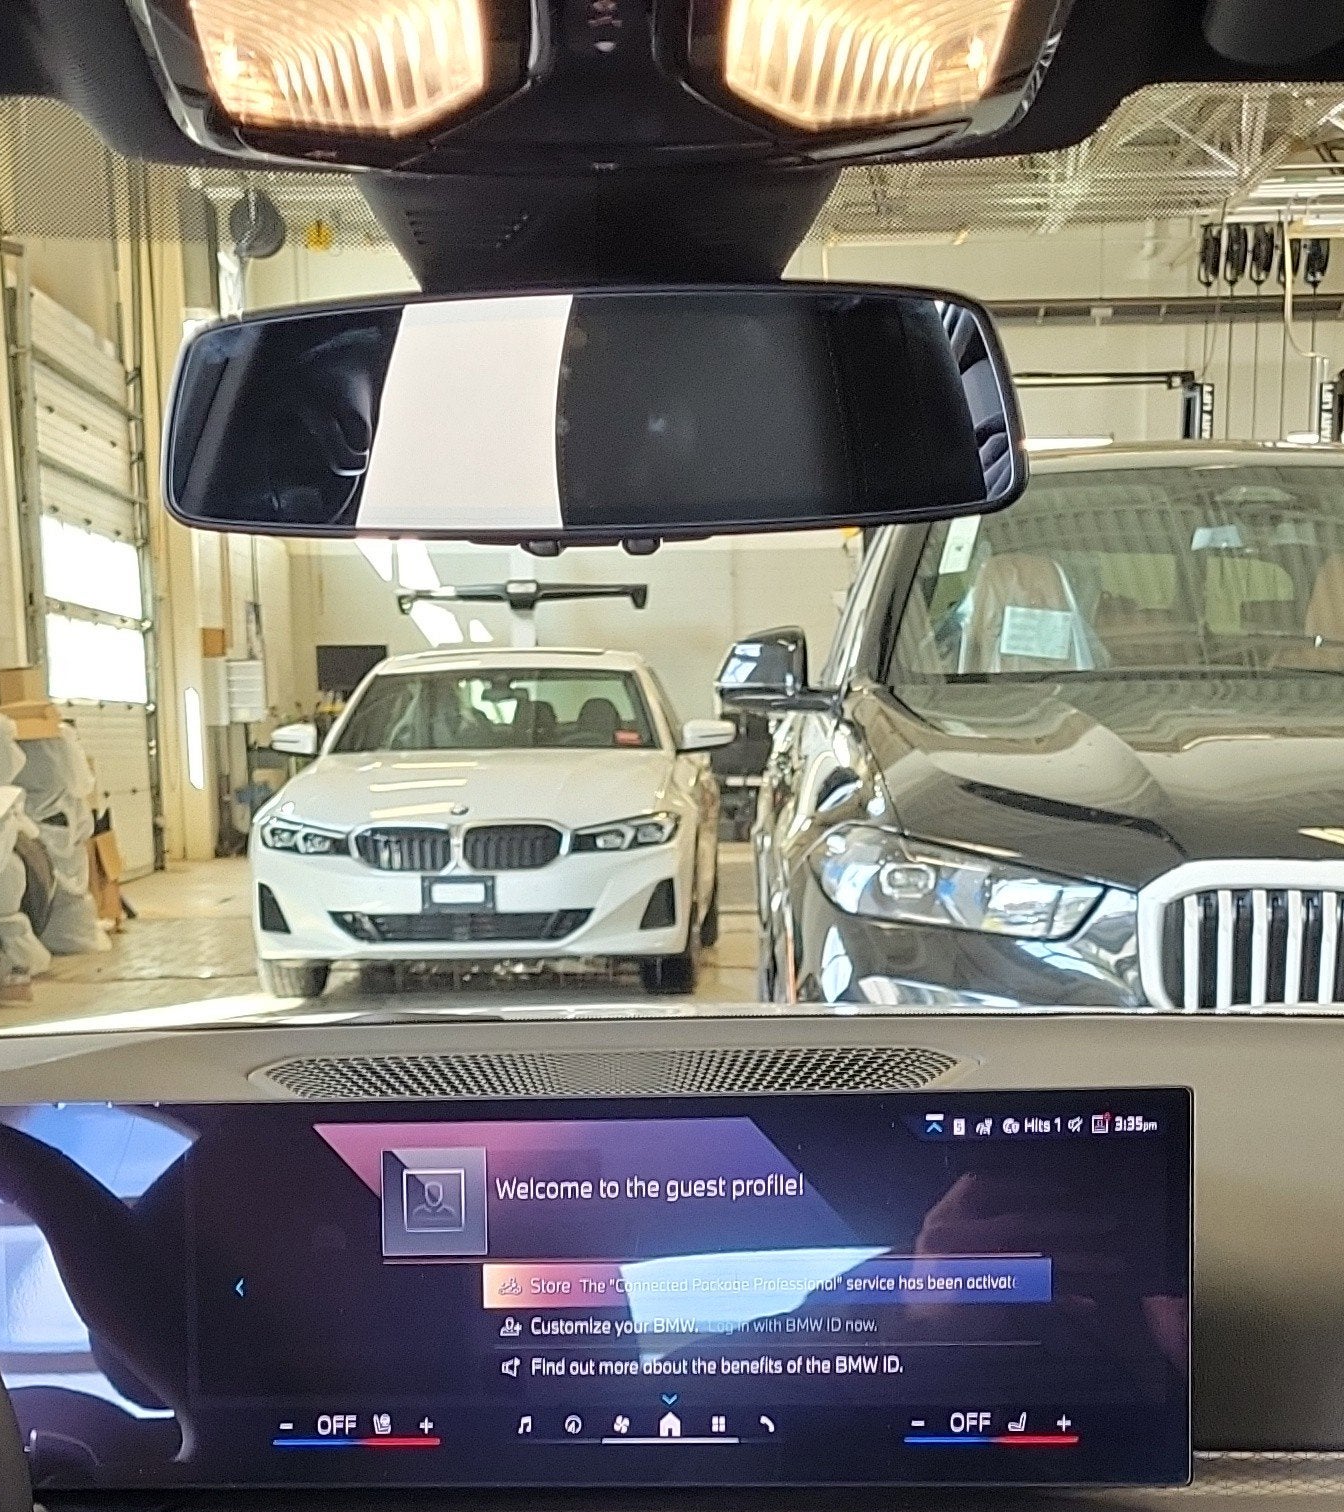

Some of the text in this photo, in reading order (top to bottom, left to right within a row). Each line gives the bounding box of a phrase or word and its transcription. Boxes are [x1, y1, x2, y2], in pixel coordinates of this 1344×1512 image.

[1202, 384, 1213, 411] LIFT
[1322, 383, 1335, 410] LIFT
[1024, 1117, 1051, 1133] Hits
[495, 1172, 804, 1202] Welcome to the guest profile!
[530, 1277, 572, 1295] Store
[580, 1278, 606, 1294] The
[609, 1277, 688, 1294] "Connected
[692, 1277, 750, 1297] Package
[753, 1275, 843, 1293] Professional"
[846, 1276, 888, 1291] service
[898, 1275, 924, 1291] has
[927, 1275, 964, 1290] been
[530, 1316, 612, 1335] Customize
[614, 1318, 650, 1338] your
[653, 1315, 700, 1334] BMW.
[754, 1317, 782, 1332] with
[786, 1317, 823, 1332] BMW
[827, 1317, 842, 1332] ID
[845, 1317, 878, 1332] now.
[531, 1355, 904, 1376] Find out more about the benefits of the BMW ID.
[317, 1414, 357, 1435] OFF
[950, 1411, 992, 1433] OFF
